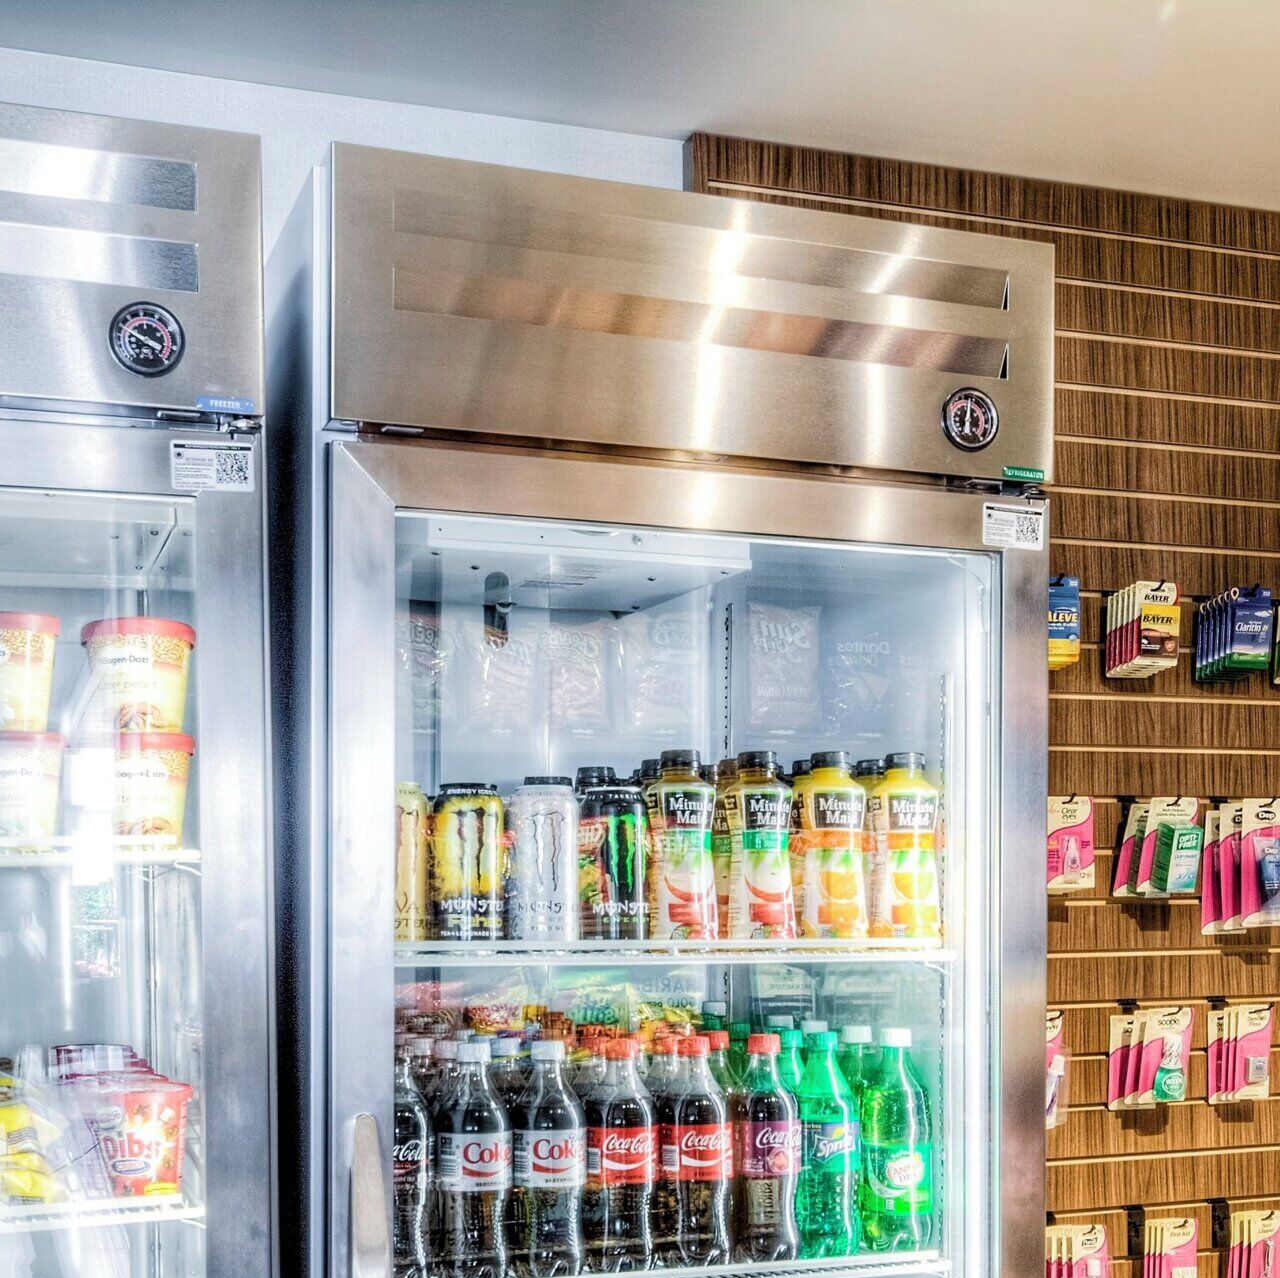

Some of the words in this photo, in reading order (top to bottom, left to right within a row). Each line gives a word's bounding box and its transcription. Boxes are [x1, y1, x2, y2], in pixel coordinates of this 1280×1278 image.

[210, 399, 240, 409] FREEZER
[1144, 594, 1169, 603] BAYER
[1143, 615, 1173, 624] BAYER
[1235, 621, 1261, 632] Claritin
[670, 797, 713, 811] Minute
[750, 798, 790, 813] Minute
[819, 797, 863, 812] Minute
[893, 800, 934, 814] Minute
[676, 811, 703, 824] Maid
[825, 811, 857, 824] Maid
[1061, 807, 1077, 815] Clear
[757, 812, 786, 825] Maid
[899, 812, 931, 826] Maid
[1179, 841, 1198, 849] FREE
[1158, 1018, 1180, 1026] scope
[603, 1134, 655, 1154] Coca-Cola
[681, 1131, 732, 1150] Coca-Cola
[819, 1136, 854, 1158] Sprite
[463, 1142, 511, 1164] Coke
[533, 1138, 584, 1160] Coke
